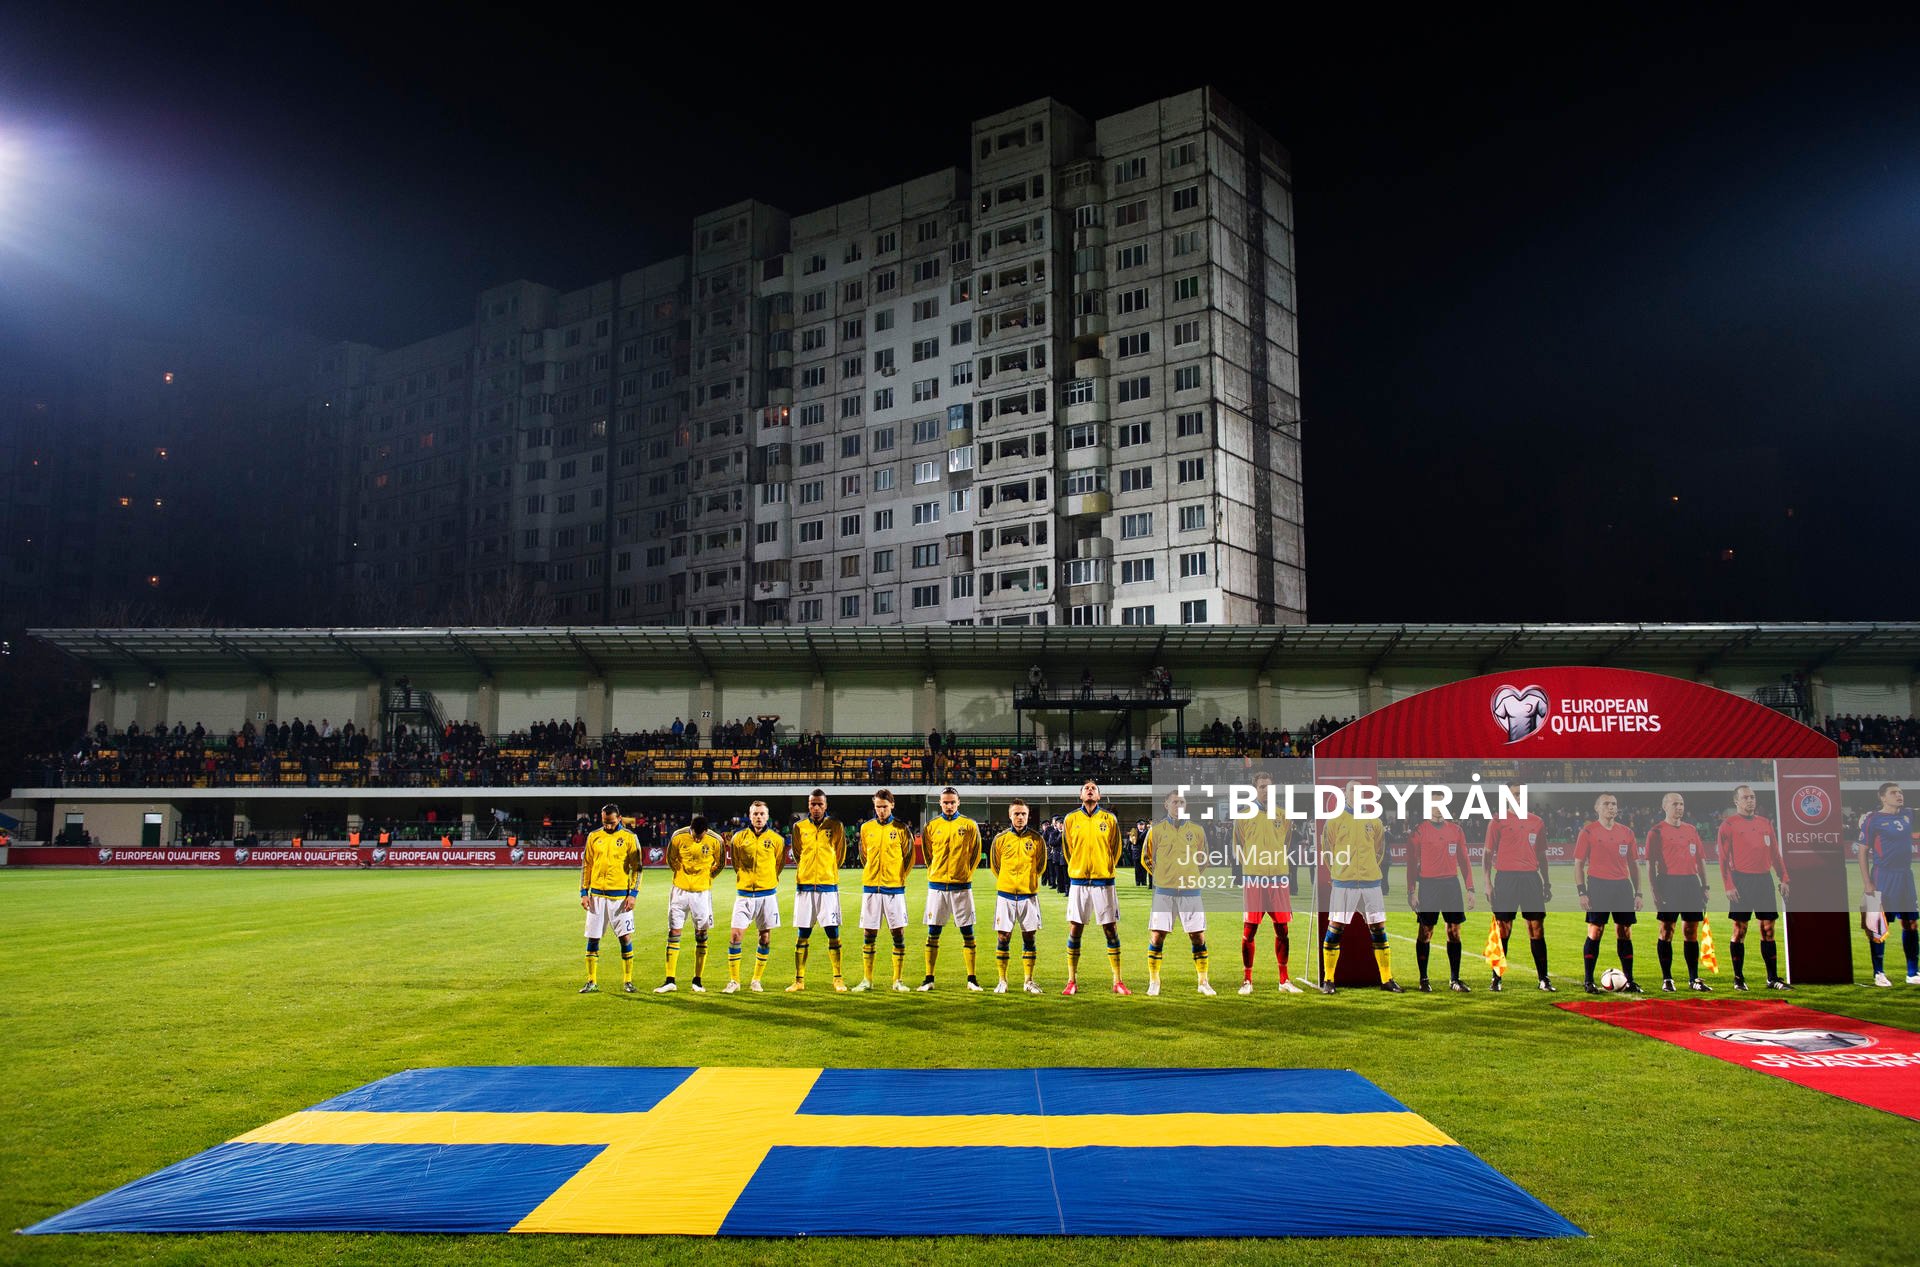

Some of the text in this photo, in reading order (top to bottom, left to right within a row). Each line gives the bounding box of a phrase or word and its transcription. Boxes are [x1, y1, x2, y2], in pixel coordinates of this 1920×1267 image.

[1561, 699, 1649, 713] EUROPEAN
[1551, 715, 1662, 735] QUALIFIERS
[1799, 788, 1822, 798] UEFA
[1893, 820, 1904, 831] 3
[1787, 832, 1840, 843] RESPECT
[115, 851, 221, 862] EUROPEAN QUALIFIERS
[252, 851, 358, 862] EUROPEAN QUALIFIERS
[389, 851, 496, 862] EUROPEAN QUALIFIERS
[527, 851, 579, 860] EUROPEAN
[773, 912, 779, 925] 7
